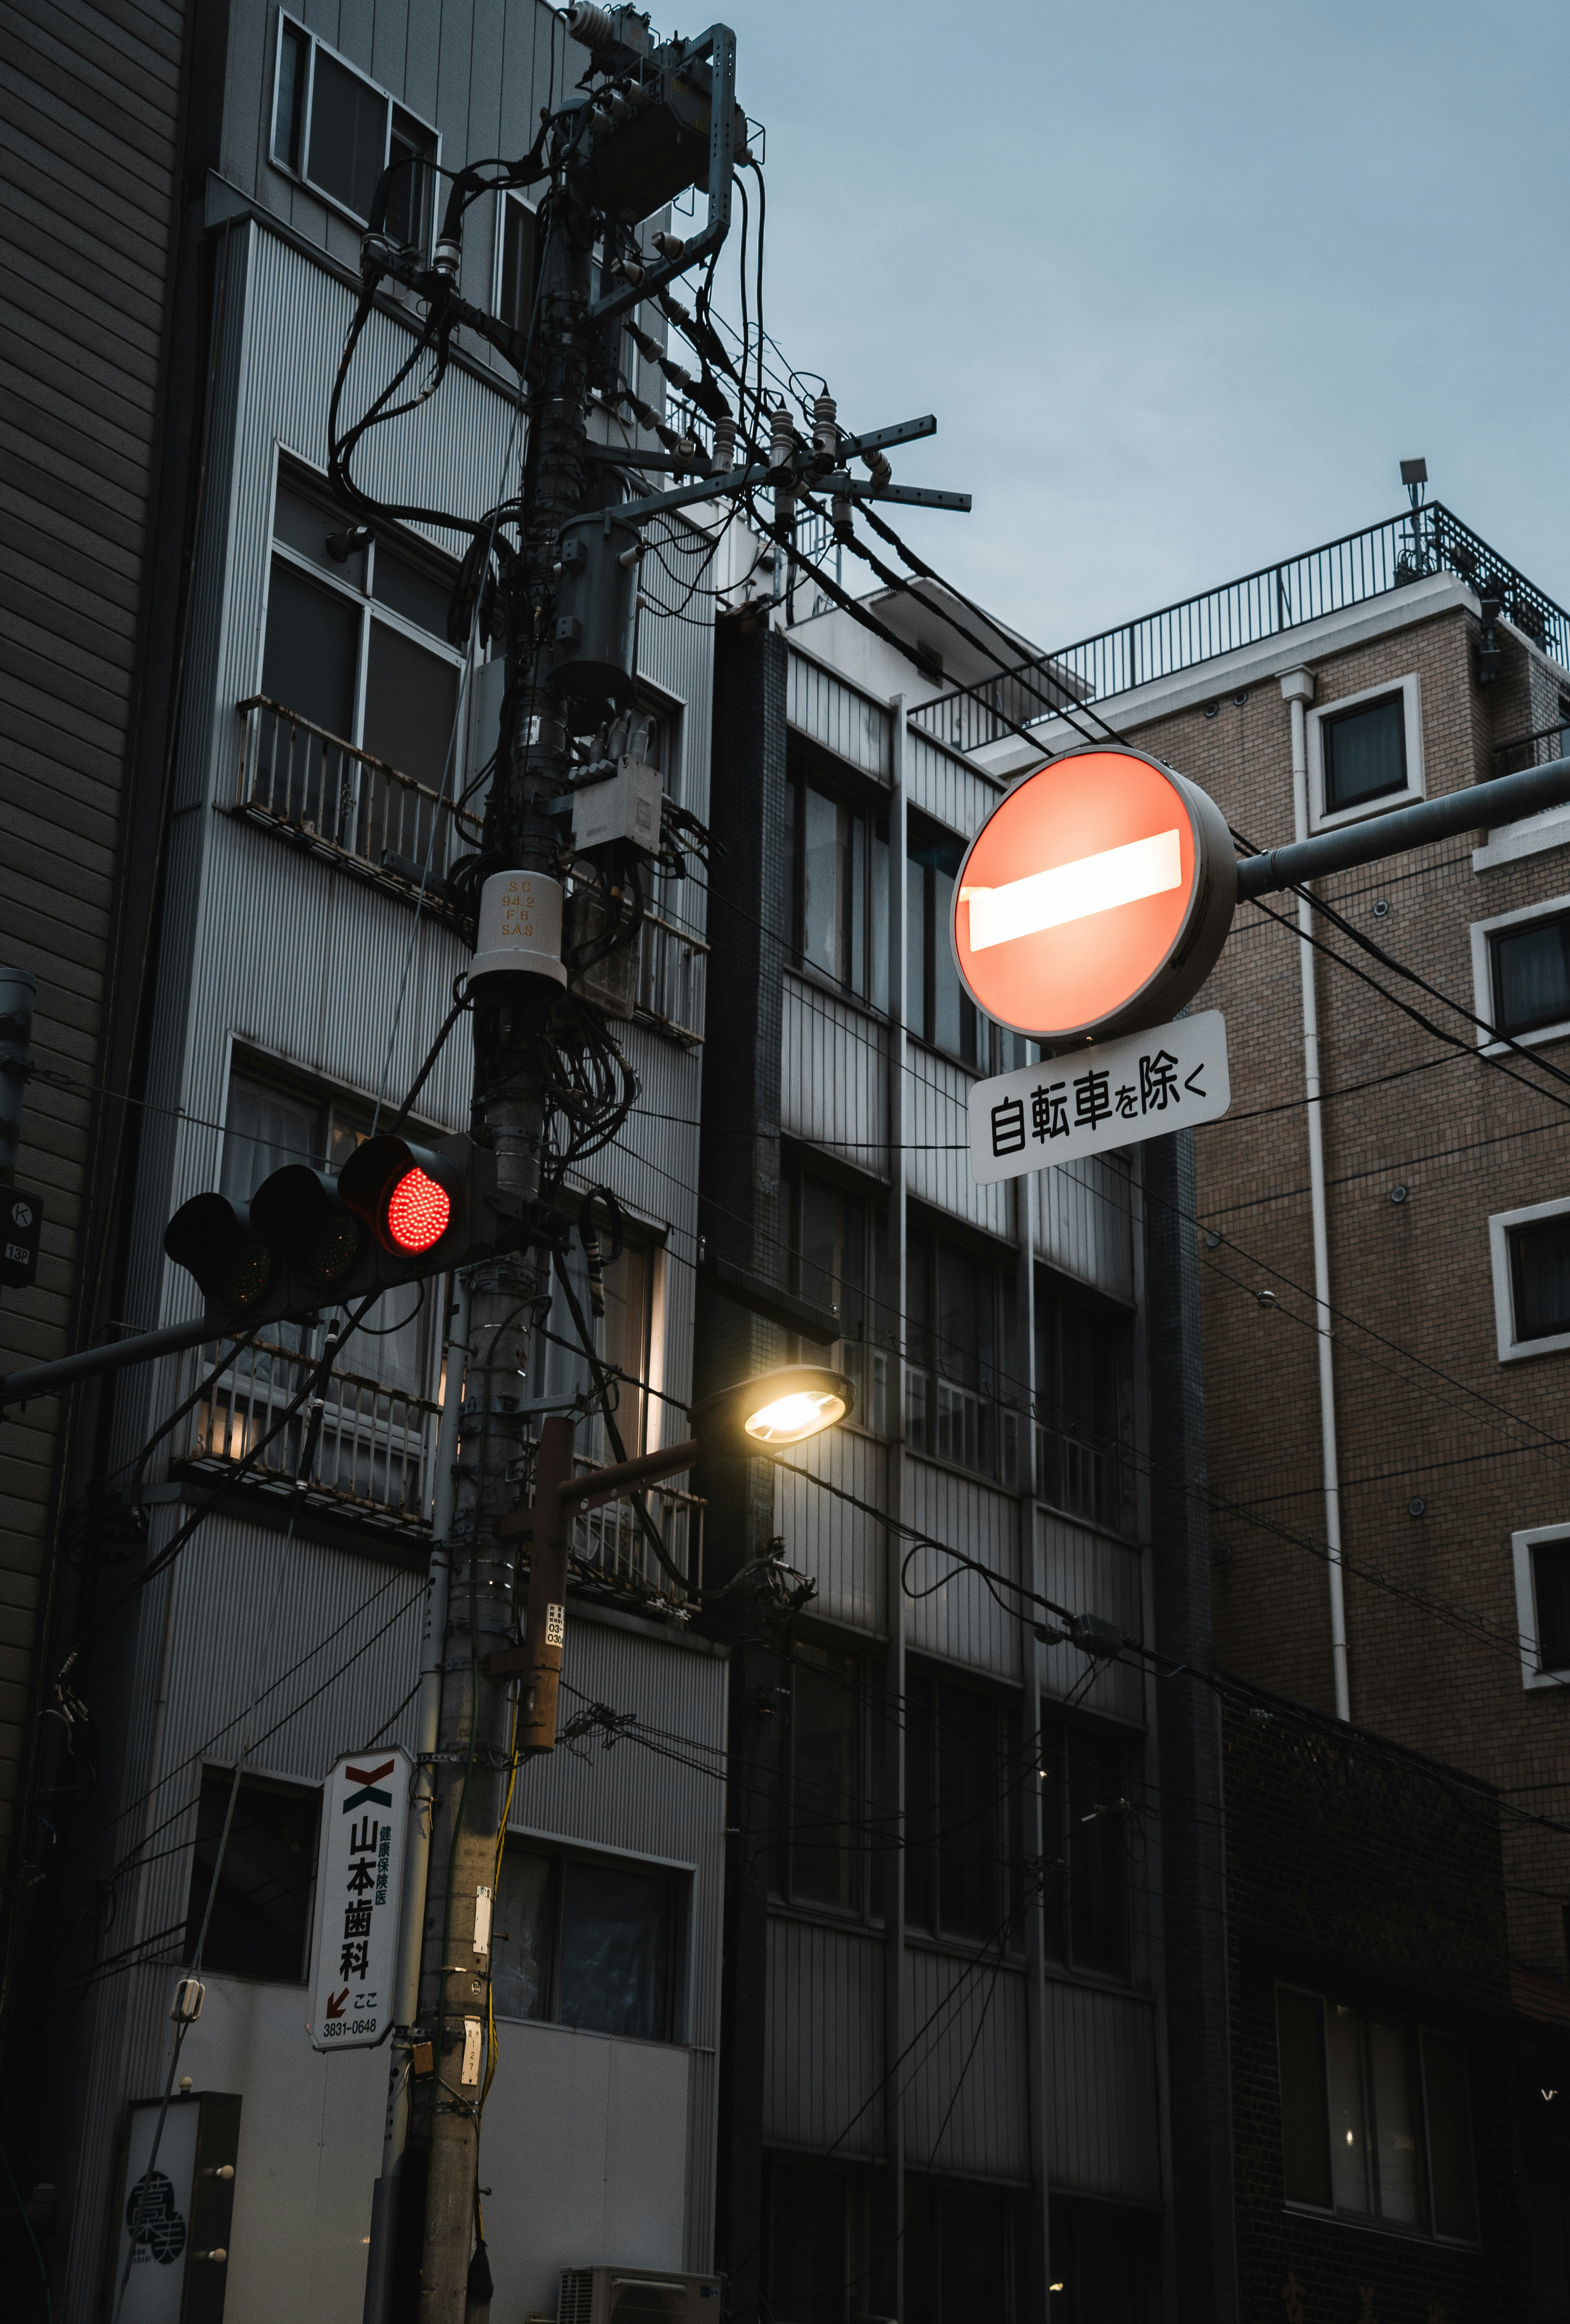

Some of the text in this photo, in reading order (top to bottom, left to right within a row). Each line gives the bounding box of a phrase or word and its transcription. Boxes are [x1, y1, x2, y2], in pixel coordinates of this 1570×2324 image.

[991, 1049, 1206, 1157] 自転車を除く
[9, 1246, 28, 1261] 13P
[549, 1624, 562, 1633] 03-
[375, 1826, 391, 1905] 健康保険医
[340, 1816, 378, 1981] 山本歯科
[354, 1992, 377, 2009] ここ
[323, 2018, 377, 2037] 3831-0648
